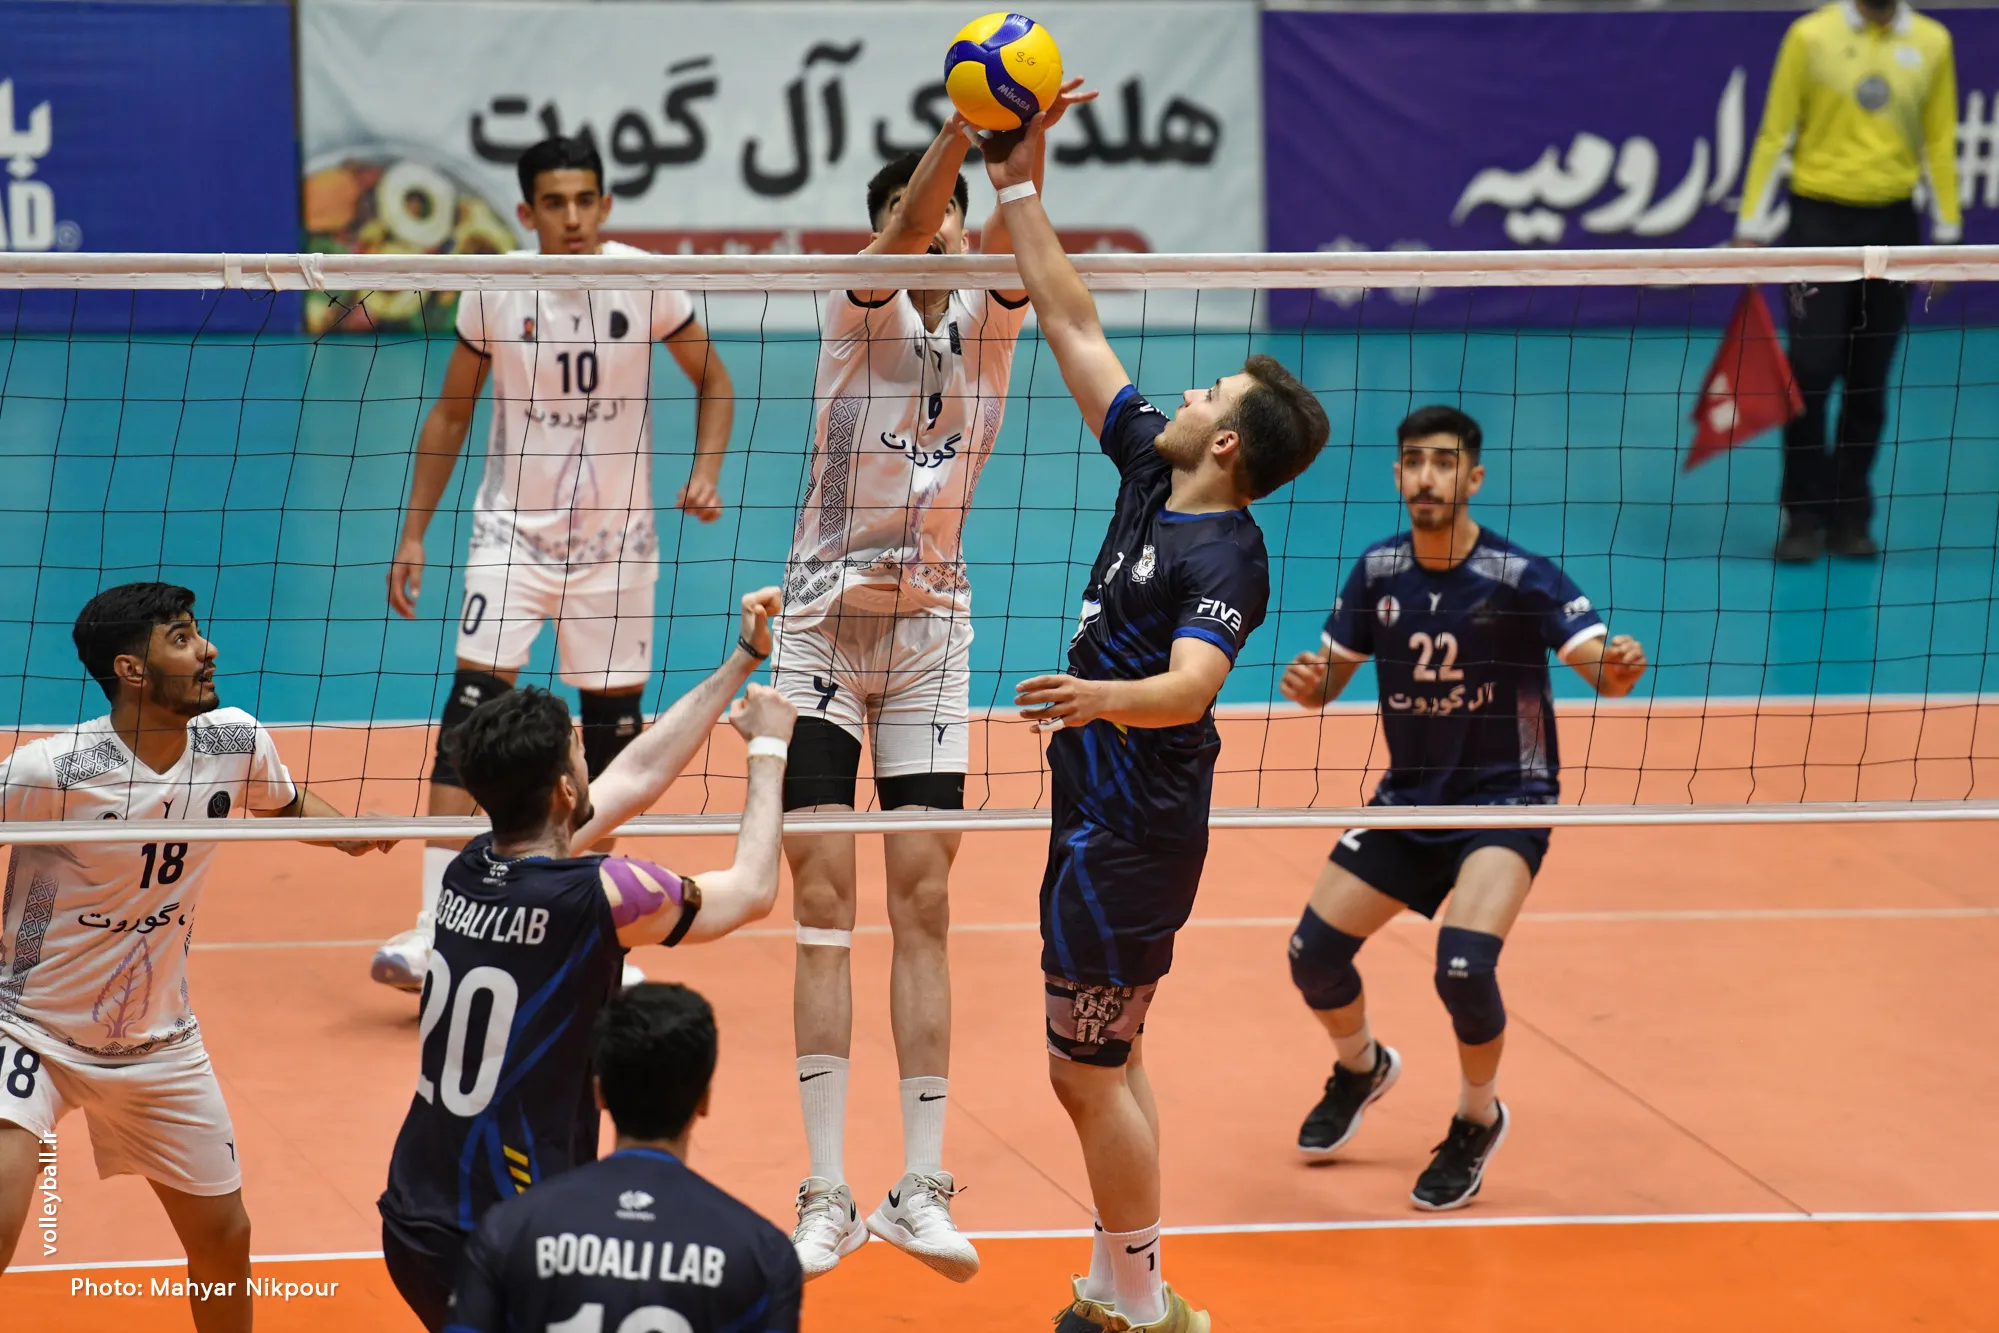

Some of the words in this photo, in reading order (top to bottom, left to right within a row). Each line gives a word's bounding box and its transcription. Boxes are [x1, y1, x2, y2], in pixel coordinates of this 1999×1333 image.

[556, 350, 598, 394] 10
[1408, 632, 1464, 682] 22
[140, 842, 188, 888] 18
[492, 906, 550, 945] LAB
[416, 948, 519, 1117] 20
[535, 1232, 654, 1280] BOOALI
[658, 1241, 726, 1288] LAB
